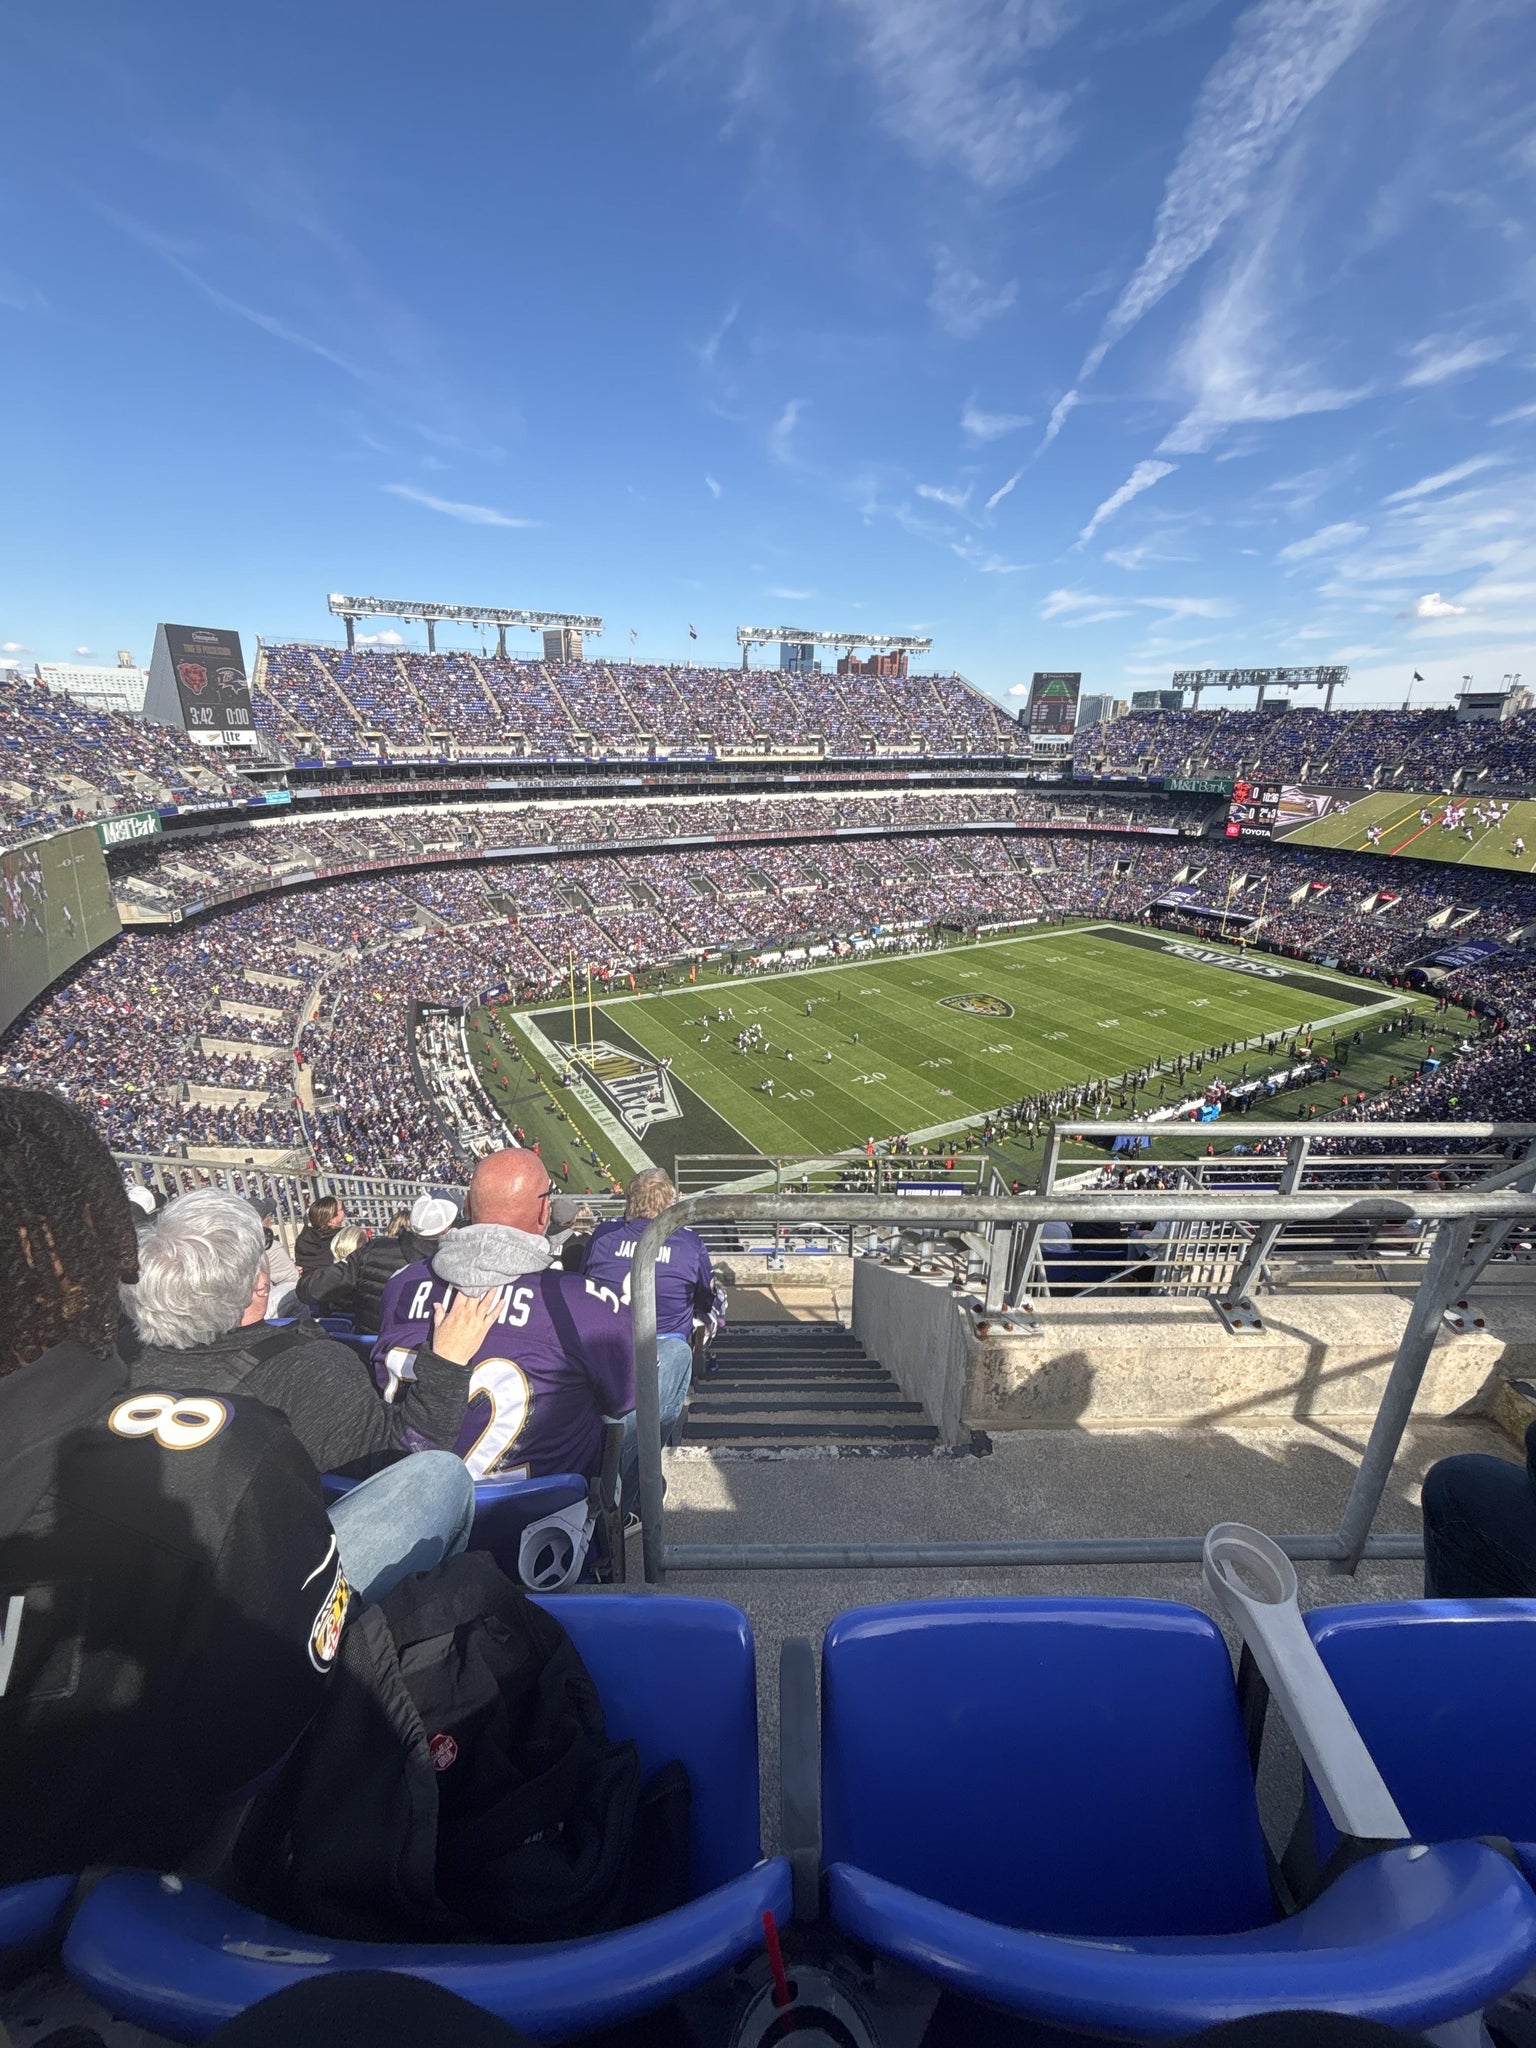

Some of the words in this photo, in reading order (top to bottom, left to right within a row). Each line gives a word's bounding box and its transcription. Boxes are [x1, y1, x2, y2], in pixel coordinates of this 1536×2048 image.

[190, 707, 215, 725] 3:42
[226, 708, 249, 725] 0:00
[320, 788, 335, 797] THE
[337, 787, 361, 795] BEARS
[363, 785, 398, 794] OFFENSE
[401, 784, 416, 792] HAS
[418, 783, 462, 791] REQUESTED
[518, 780, 541, 788] PLEASE
[544, 779, 574, 787] RESPOND
[1170, 779, 1199, 792] M&T
[1200, 781, 1226, 793] Bank
[1252, 787, 1259, 799] 0
[1249, 808, 1255, 819] 0
[102, 818, 132, 844] M&T
[131, 813, 157, 838] Bank
[1241, 828, 1271, 837] TOYOTA
[558, 843, 582, 851] PLEASE
[315, 869, 331, 878] THE
[331, 865, 354, 875] BEARS
[357, 860, 390, 871] OFFENSE
[394, 858, 409, 866] HAS
[1161, 941, 1285, 978] RAVENS
[857, 1072, 887, 1084] 20
[783, 1088, 815, 1101] 10
[408, 1281, 433, 1319] R.
[108, 1393, 227, 1451] 8
